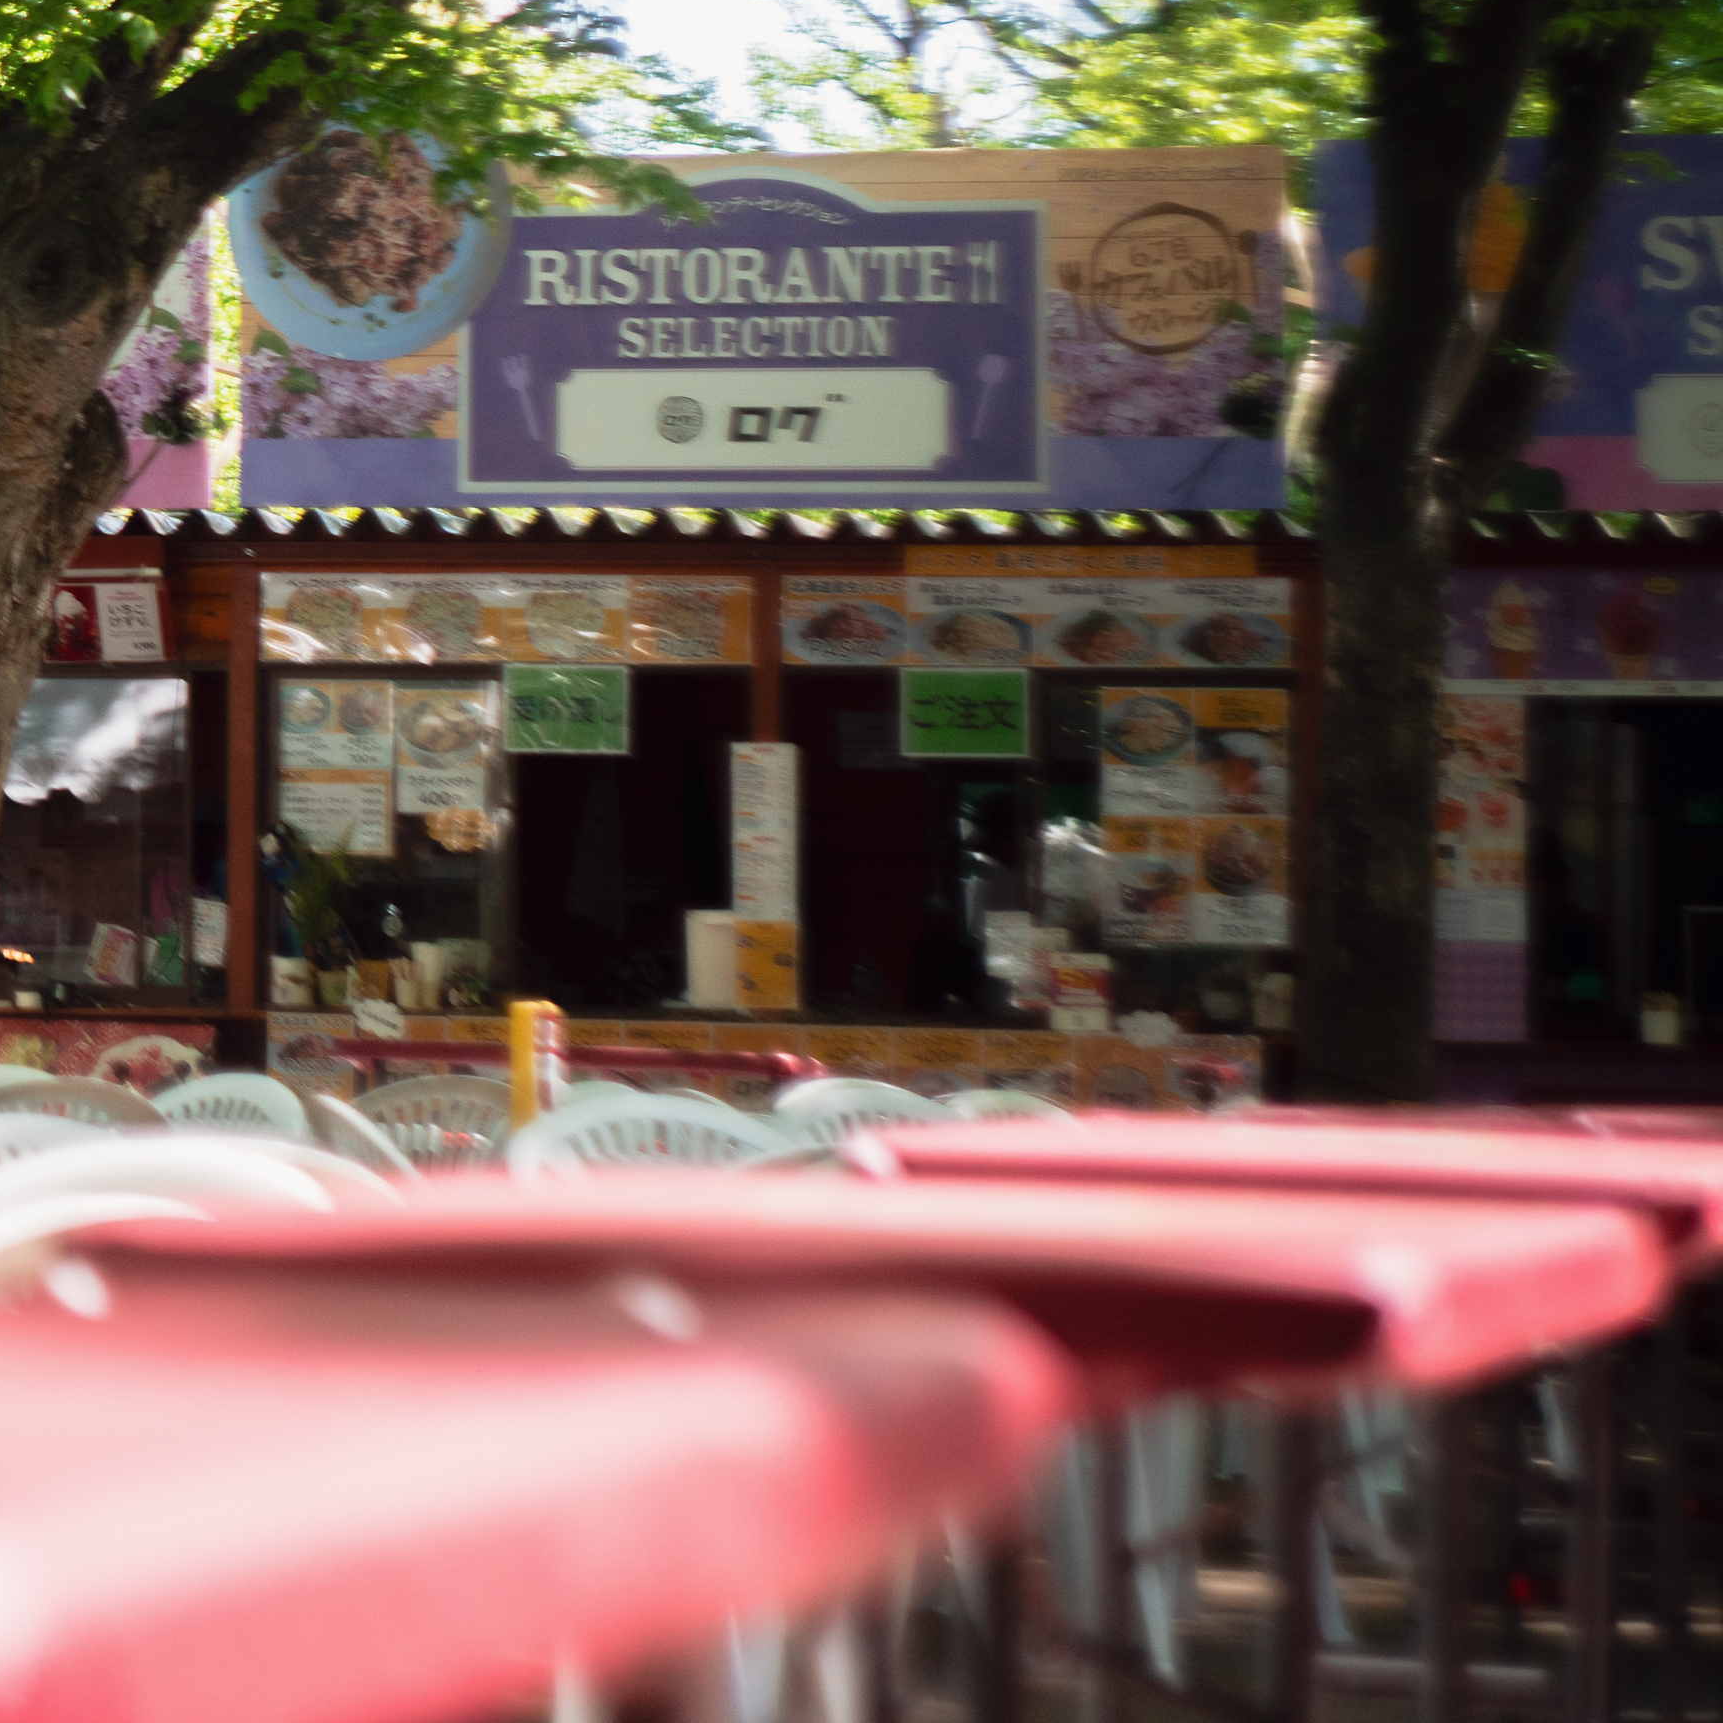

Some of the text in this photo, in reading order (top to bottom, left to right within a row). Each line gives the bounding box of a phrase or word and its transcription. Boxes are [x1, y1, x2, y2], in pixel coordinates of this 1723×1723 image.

[523, 244, 955, 306] RISTORANTE
[616, 315, 895, 359] SELECTION
[724, 392, 850, 443] ログ
[909, 694, 1019, 731] ご注文
